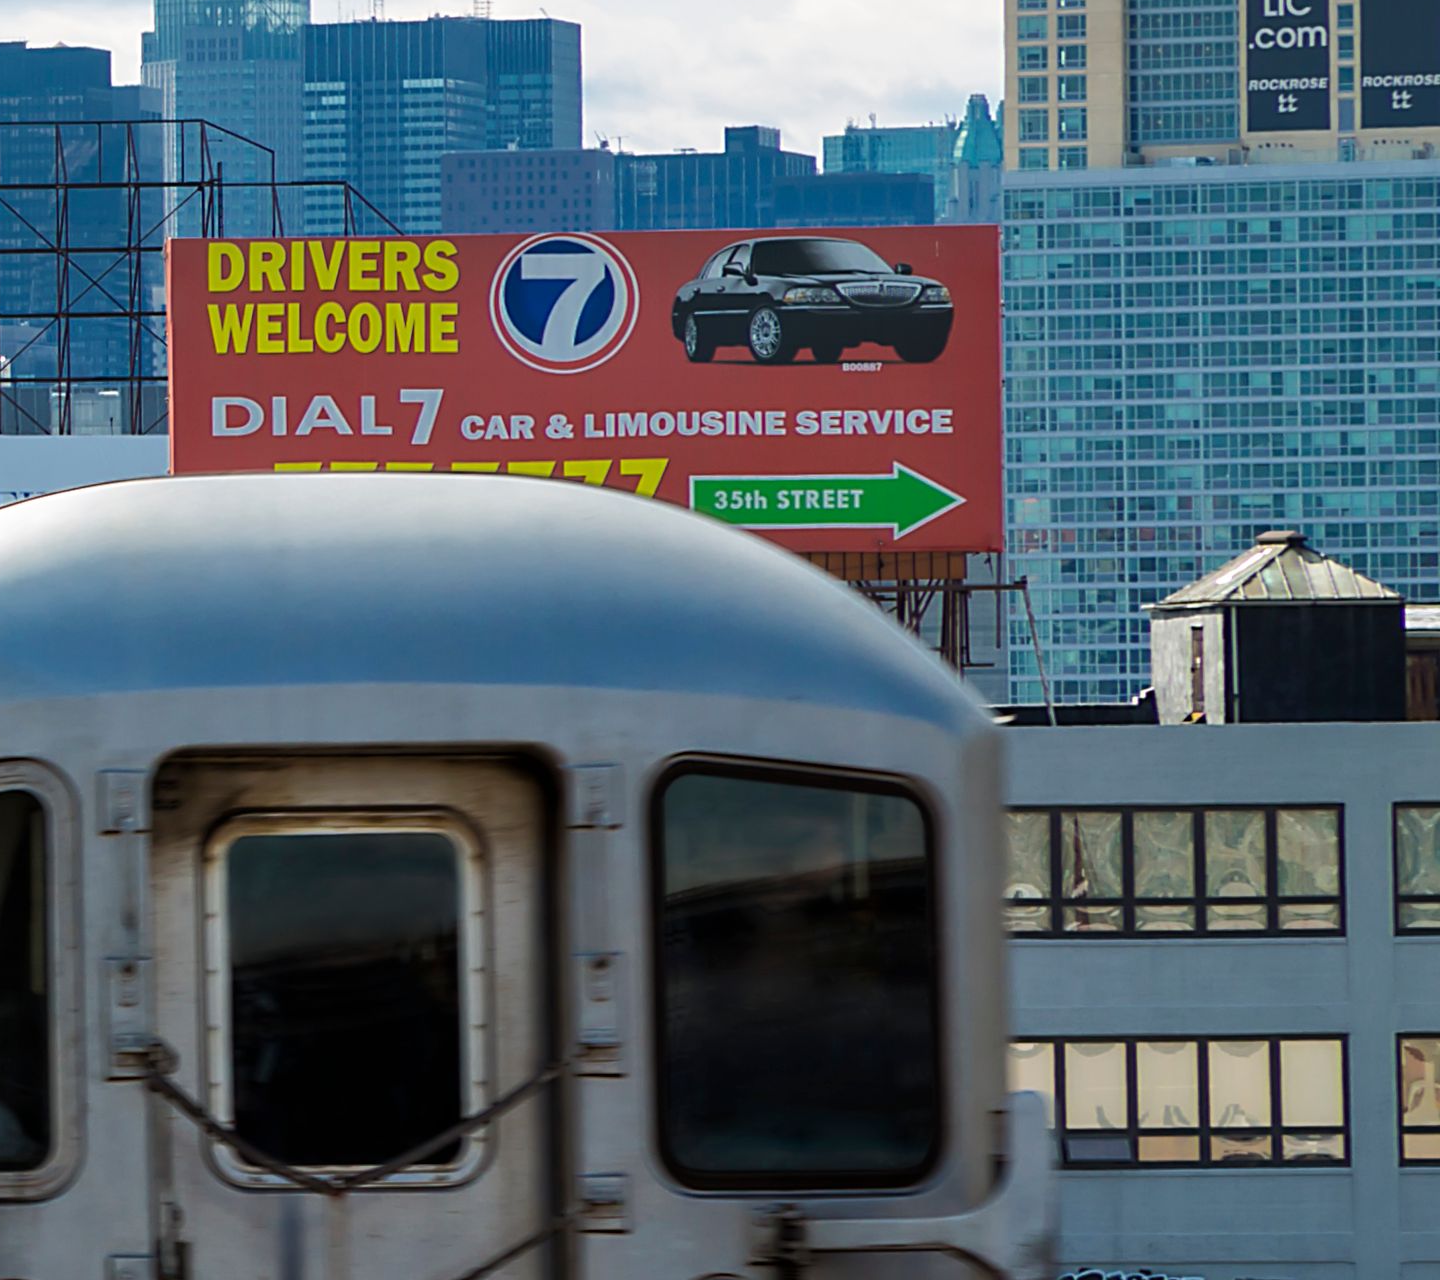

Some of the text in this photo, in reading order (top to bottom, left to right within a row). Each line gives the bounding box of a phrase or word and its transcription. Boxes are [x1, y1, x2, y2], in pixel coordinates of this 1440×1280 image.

[1248, 25, 1328, 50] .com
[1248, 77, 1329, 92] ROCKROSE
[1362, 73, 1440, 88] ROCKROSE
[207, 239, 460, 293] DRIVERS
[207, 301, 460, 355] WELCOME
[461, 414, 534, 441] CAR
[545, 413, 575, 440] &
[584, 410, 787, 439] LIMOUSINE
[795, 409, 954, 436] SERVICE
[714, 489, 865, 509] 35th STREET
